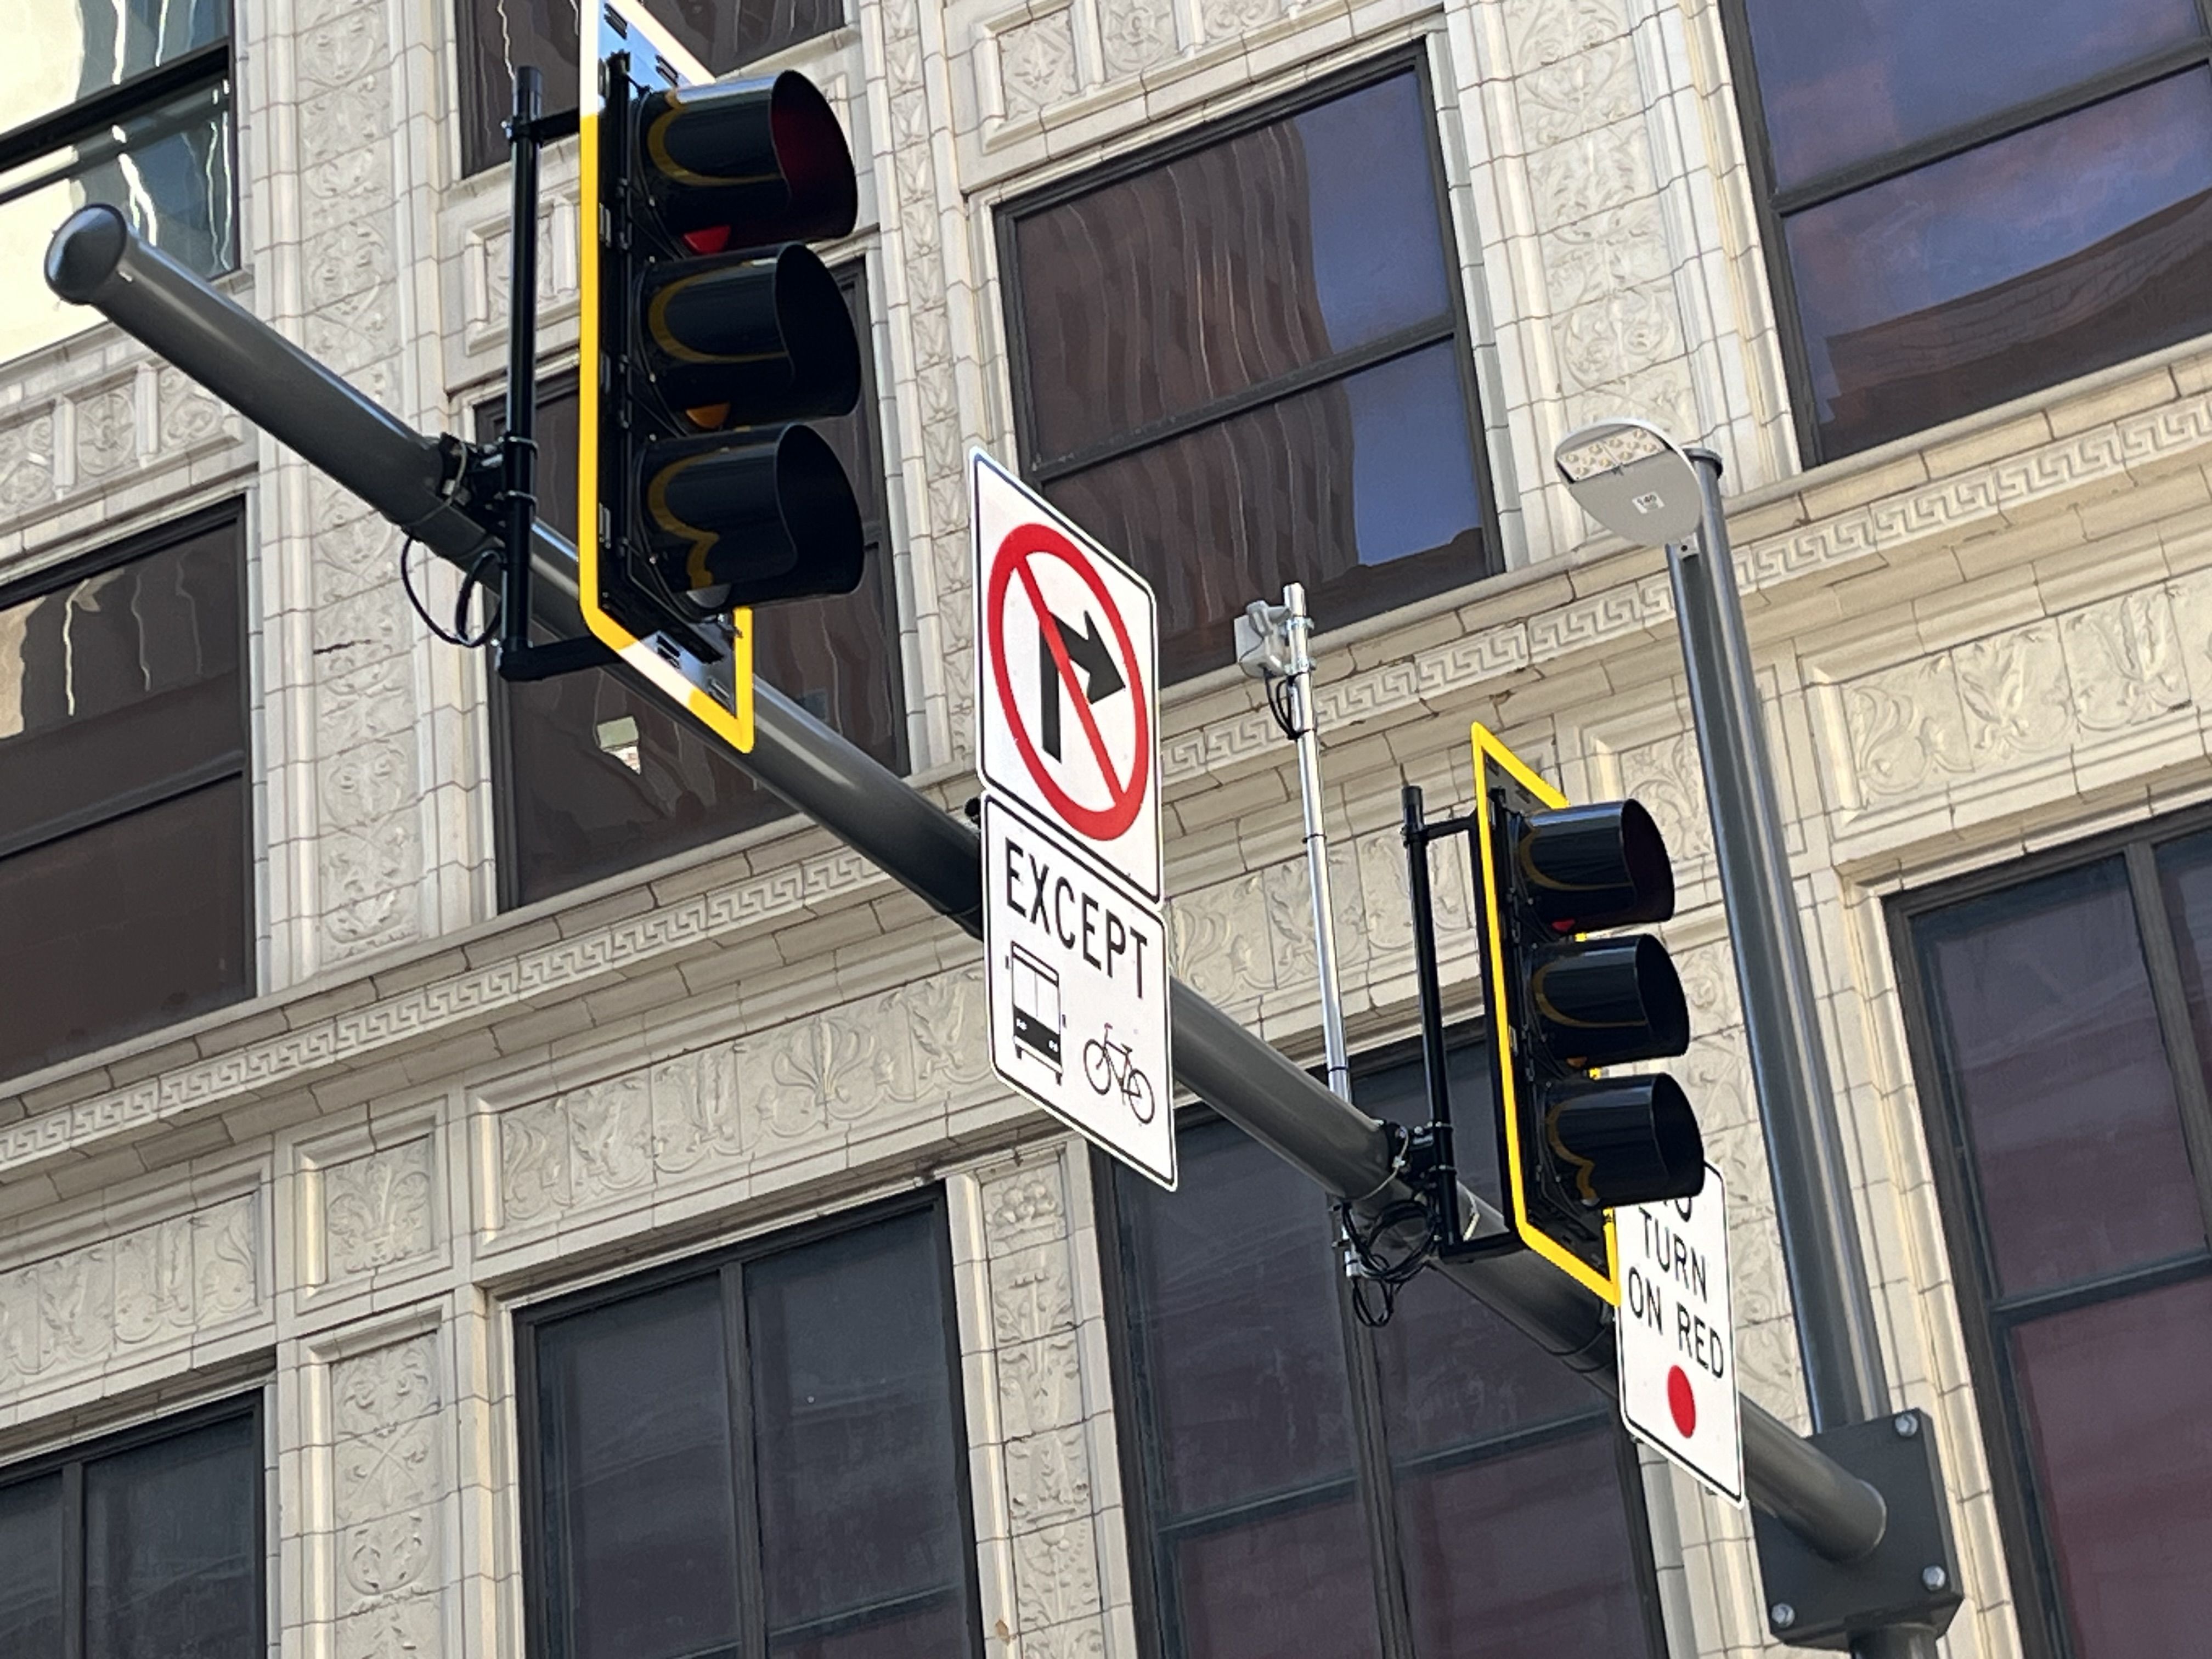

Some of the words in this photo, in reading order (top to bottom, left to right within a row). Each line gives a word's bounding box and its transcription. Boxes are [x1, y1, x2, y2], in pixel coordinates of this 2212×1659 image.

[1005, 837, 1148, 999] EXCEPT
[1639, 1205, 1707, 1304] TURN
[1628, 1266, 1663, 1336] ON
[1677, 1301, 1724, 1379] RED
